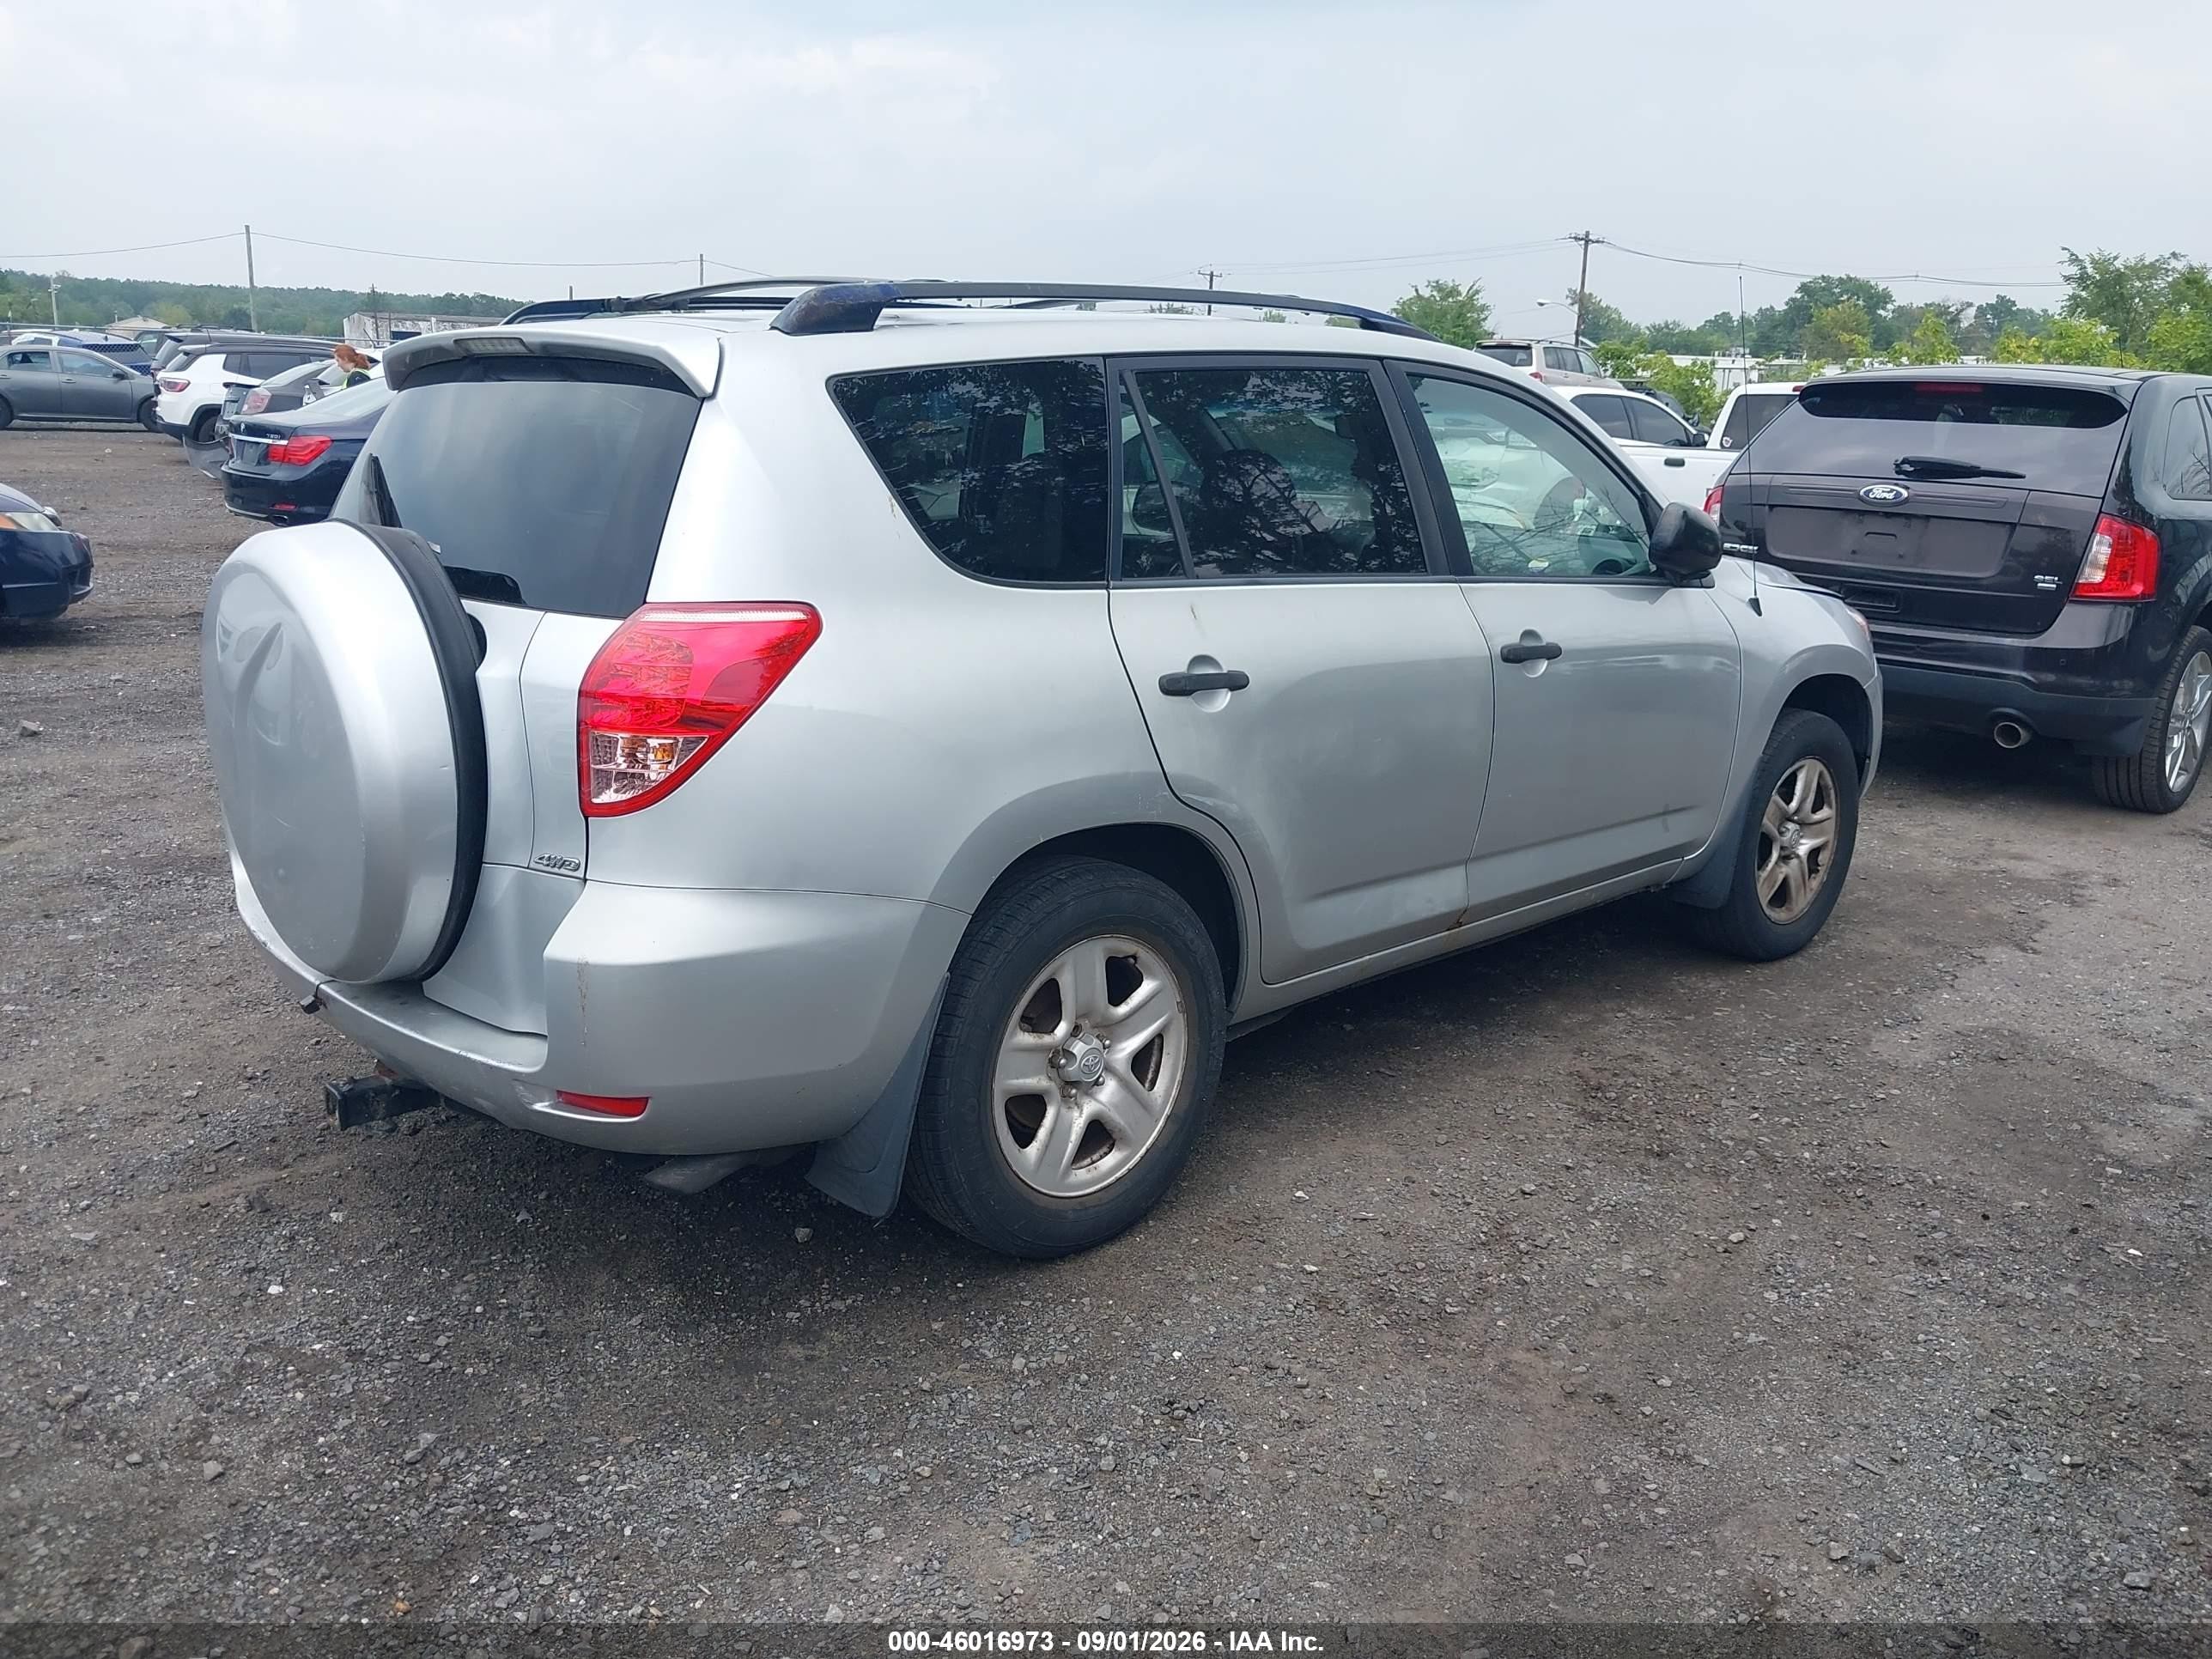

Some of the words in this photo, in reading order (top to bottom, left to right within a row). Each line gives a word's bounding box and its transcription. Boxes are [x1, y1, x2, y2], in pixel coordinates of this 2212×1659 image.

[1869, 487, 1897, 500] Ford
[2033, 574, 2063, 585] SEL
[533, 853, 581, 872] 4WD
